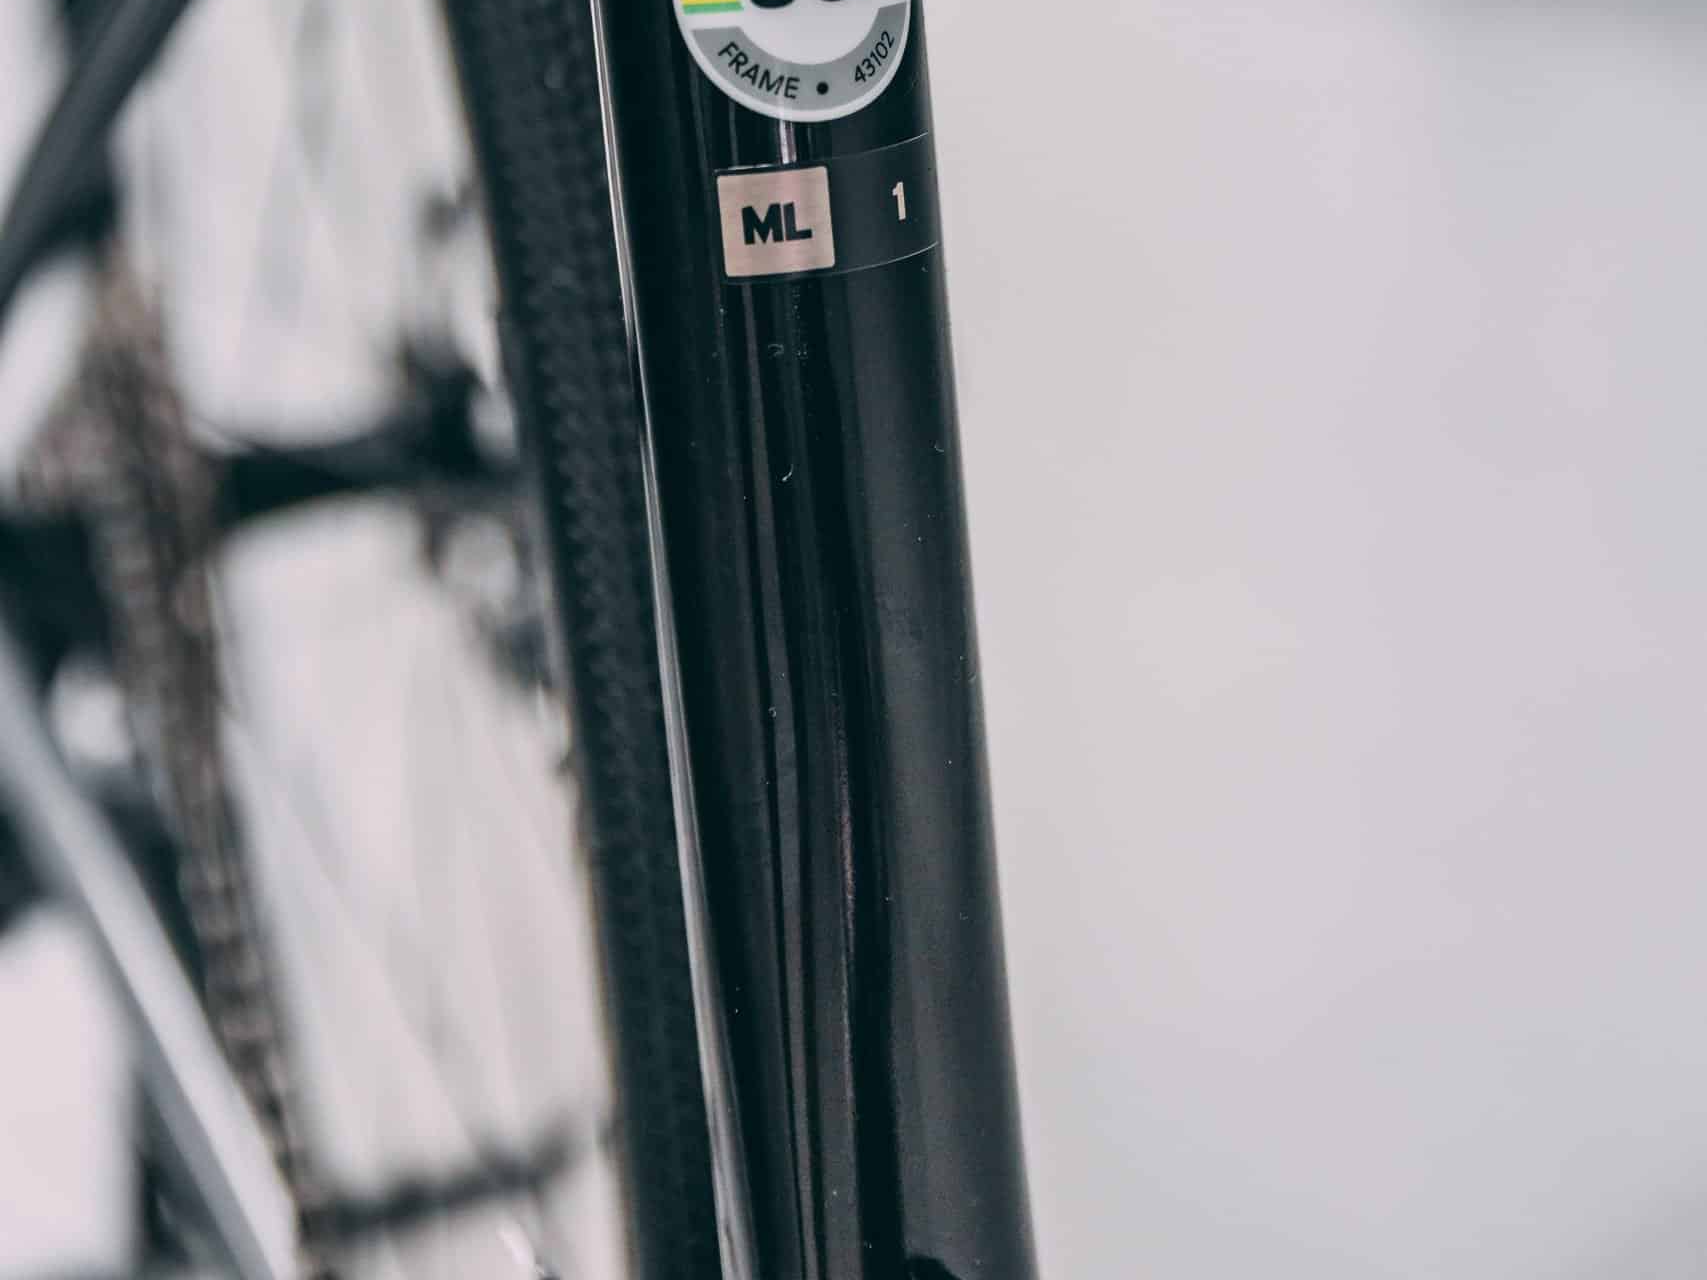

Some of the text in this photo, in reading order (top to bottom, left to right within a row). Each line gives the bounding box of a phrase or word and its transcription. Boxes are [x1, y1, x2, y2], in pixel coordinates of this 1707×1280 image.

[718, 31, 895, 99] FRAME 43102
[741, 181, 906, 245] ML 1
